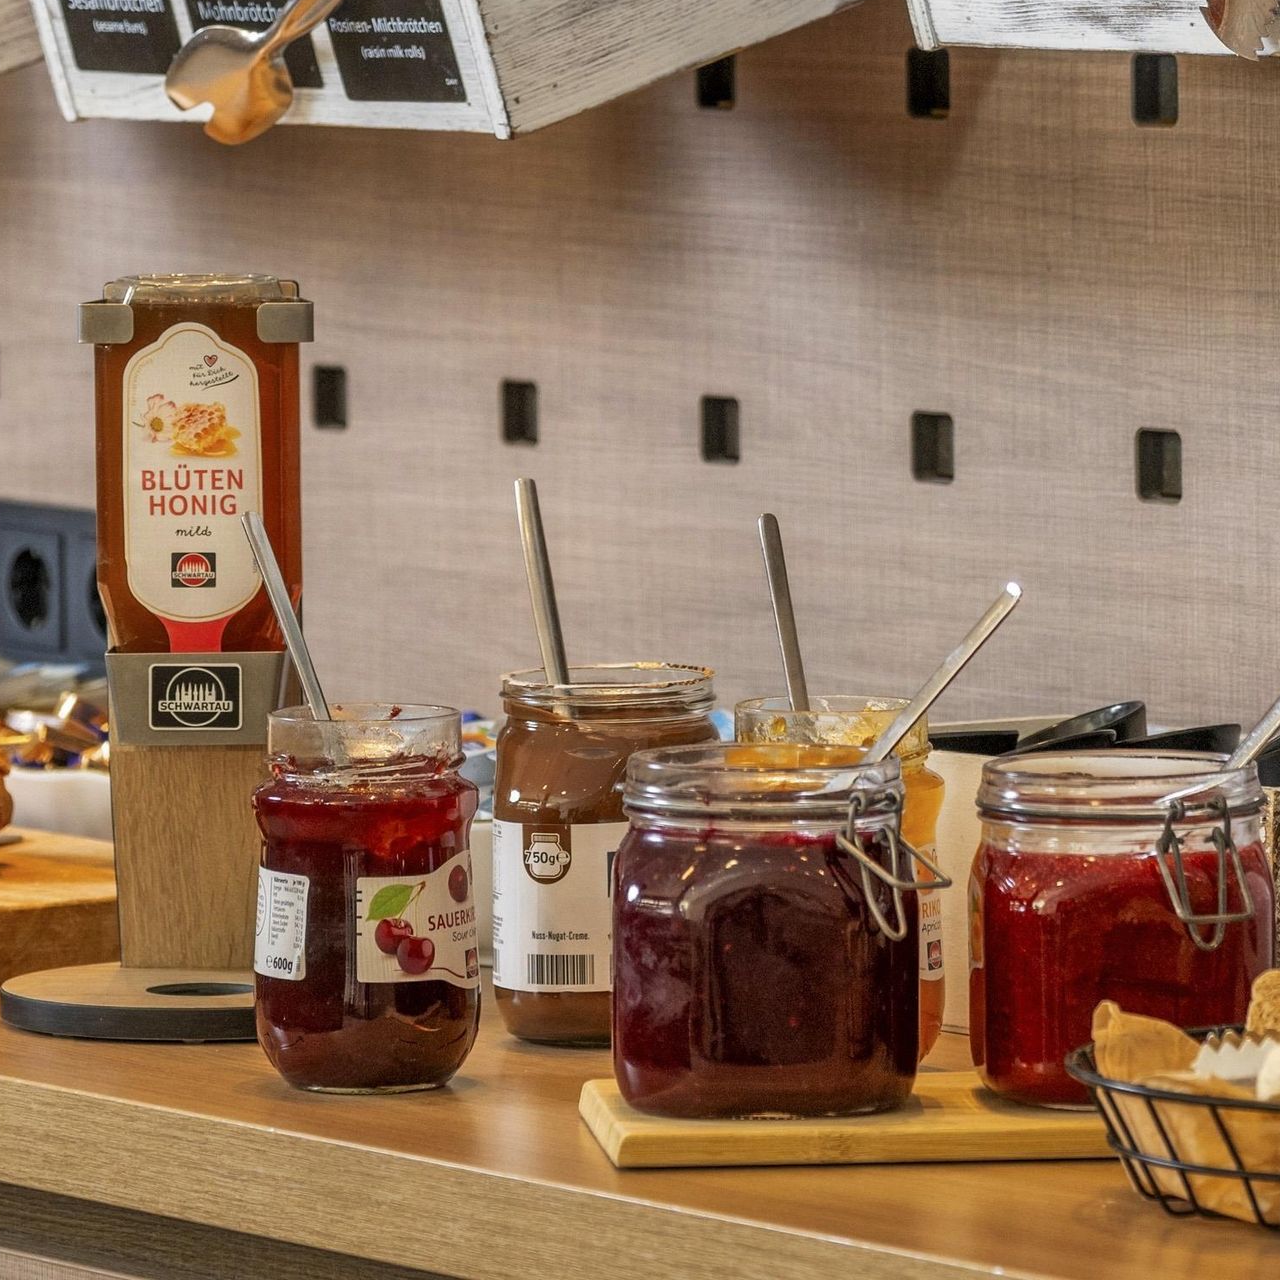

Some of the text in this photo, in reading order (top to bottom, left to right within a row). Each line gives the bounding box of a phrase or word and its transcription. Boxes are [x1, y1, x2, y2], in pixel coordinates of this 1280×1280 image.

[197, 1, 282, 24] Mohnbrötche
[371, 17, 443, 33] Milchbrötchen
[141, 464, 244, 491] BLÜTEN
[149, 494, 237, 516] HONIG
[175, 526, 212, 537] mild
[160, 701, 230, 711] SCHWARTAU
[525, 851, 556, 866] 750g
[273, 957, 293, 974] 600g
